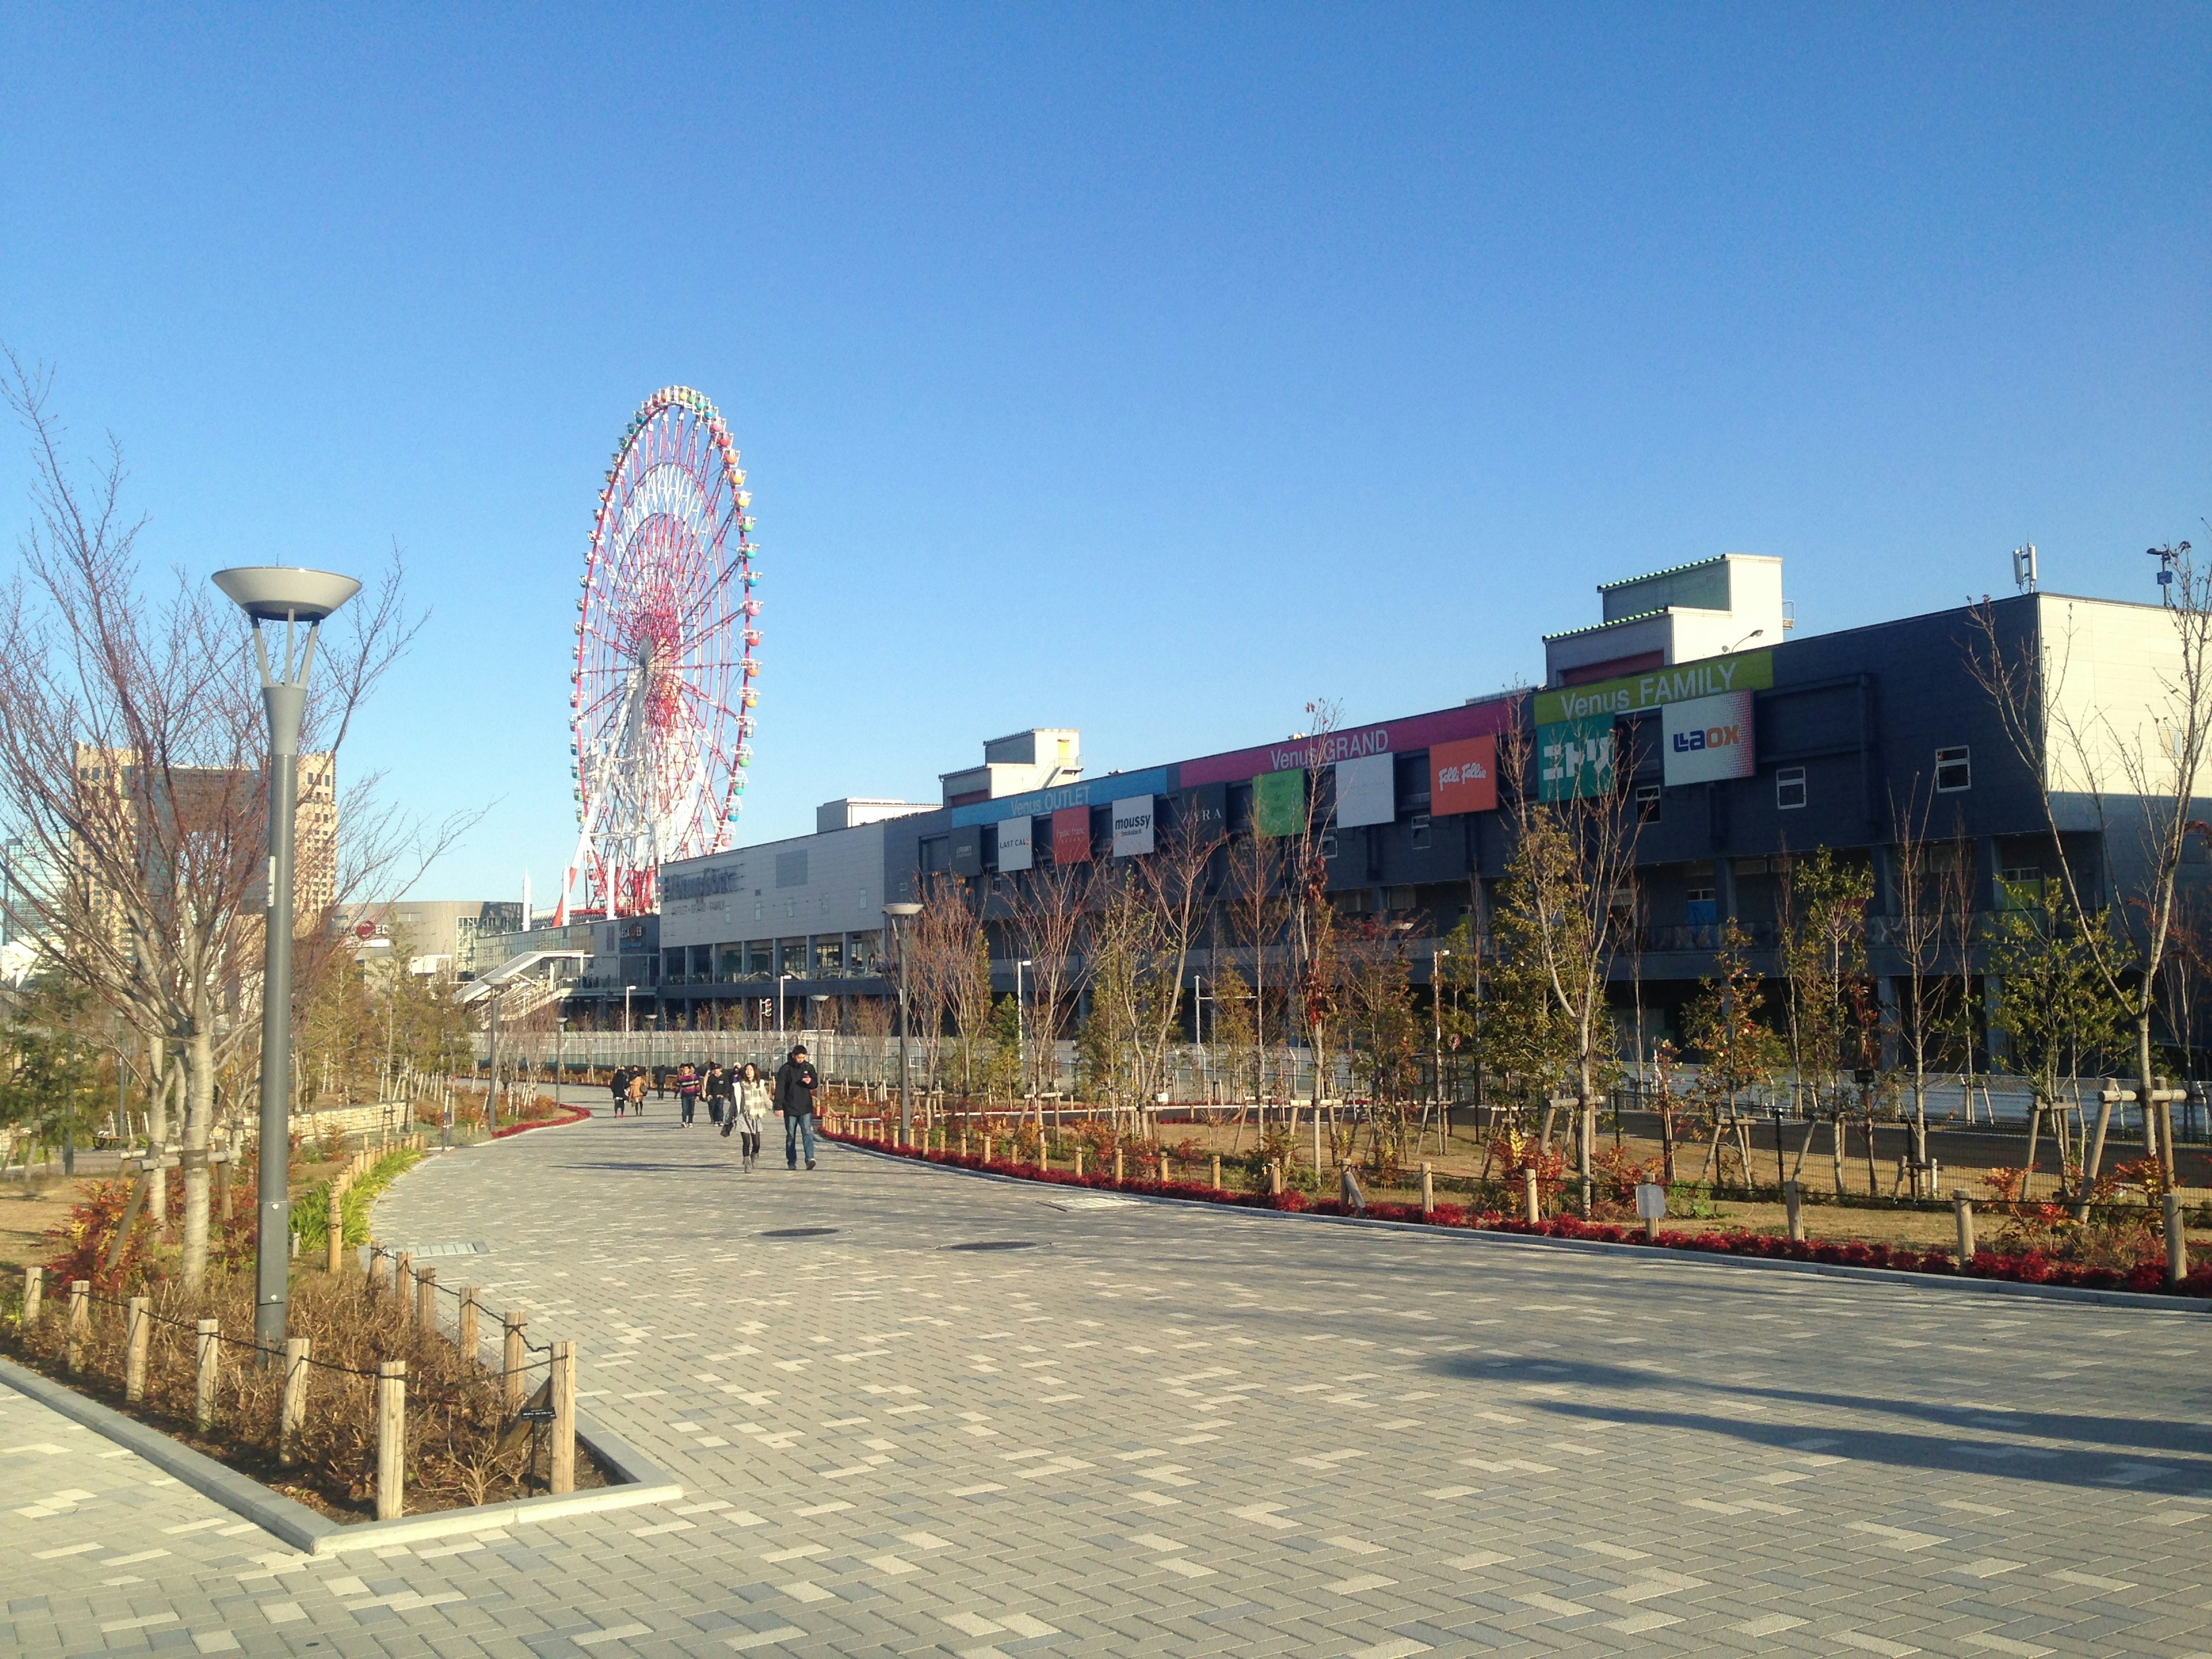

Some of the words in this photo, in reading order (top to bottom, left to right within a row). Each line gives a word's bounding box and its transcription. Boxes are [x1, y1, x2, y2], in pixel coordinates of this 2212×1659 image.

[1560, 689, 1631, 719] Venus
[1639, 662, 1737, 706] FAMILY
[1271, 747, 1318, 770] Venus
[1325, 729, 1389, 762] GRAND
[1543, 737, 1612, 781] ニトリ
[1438, 767, 1460, 792] Folli
[1461, 762, 1487, 785] Follie
[1010, 798, 1041, 816] Venus
[1044, 785, 1090, 810] OUTLET
[1115, 814, 1151, 830] moussy
[999, 840, 1014, 849] LAST
[1014, 838, 1030, 847] CAL
